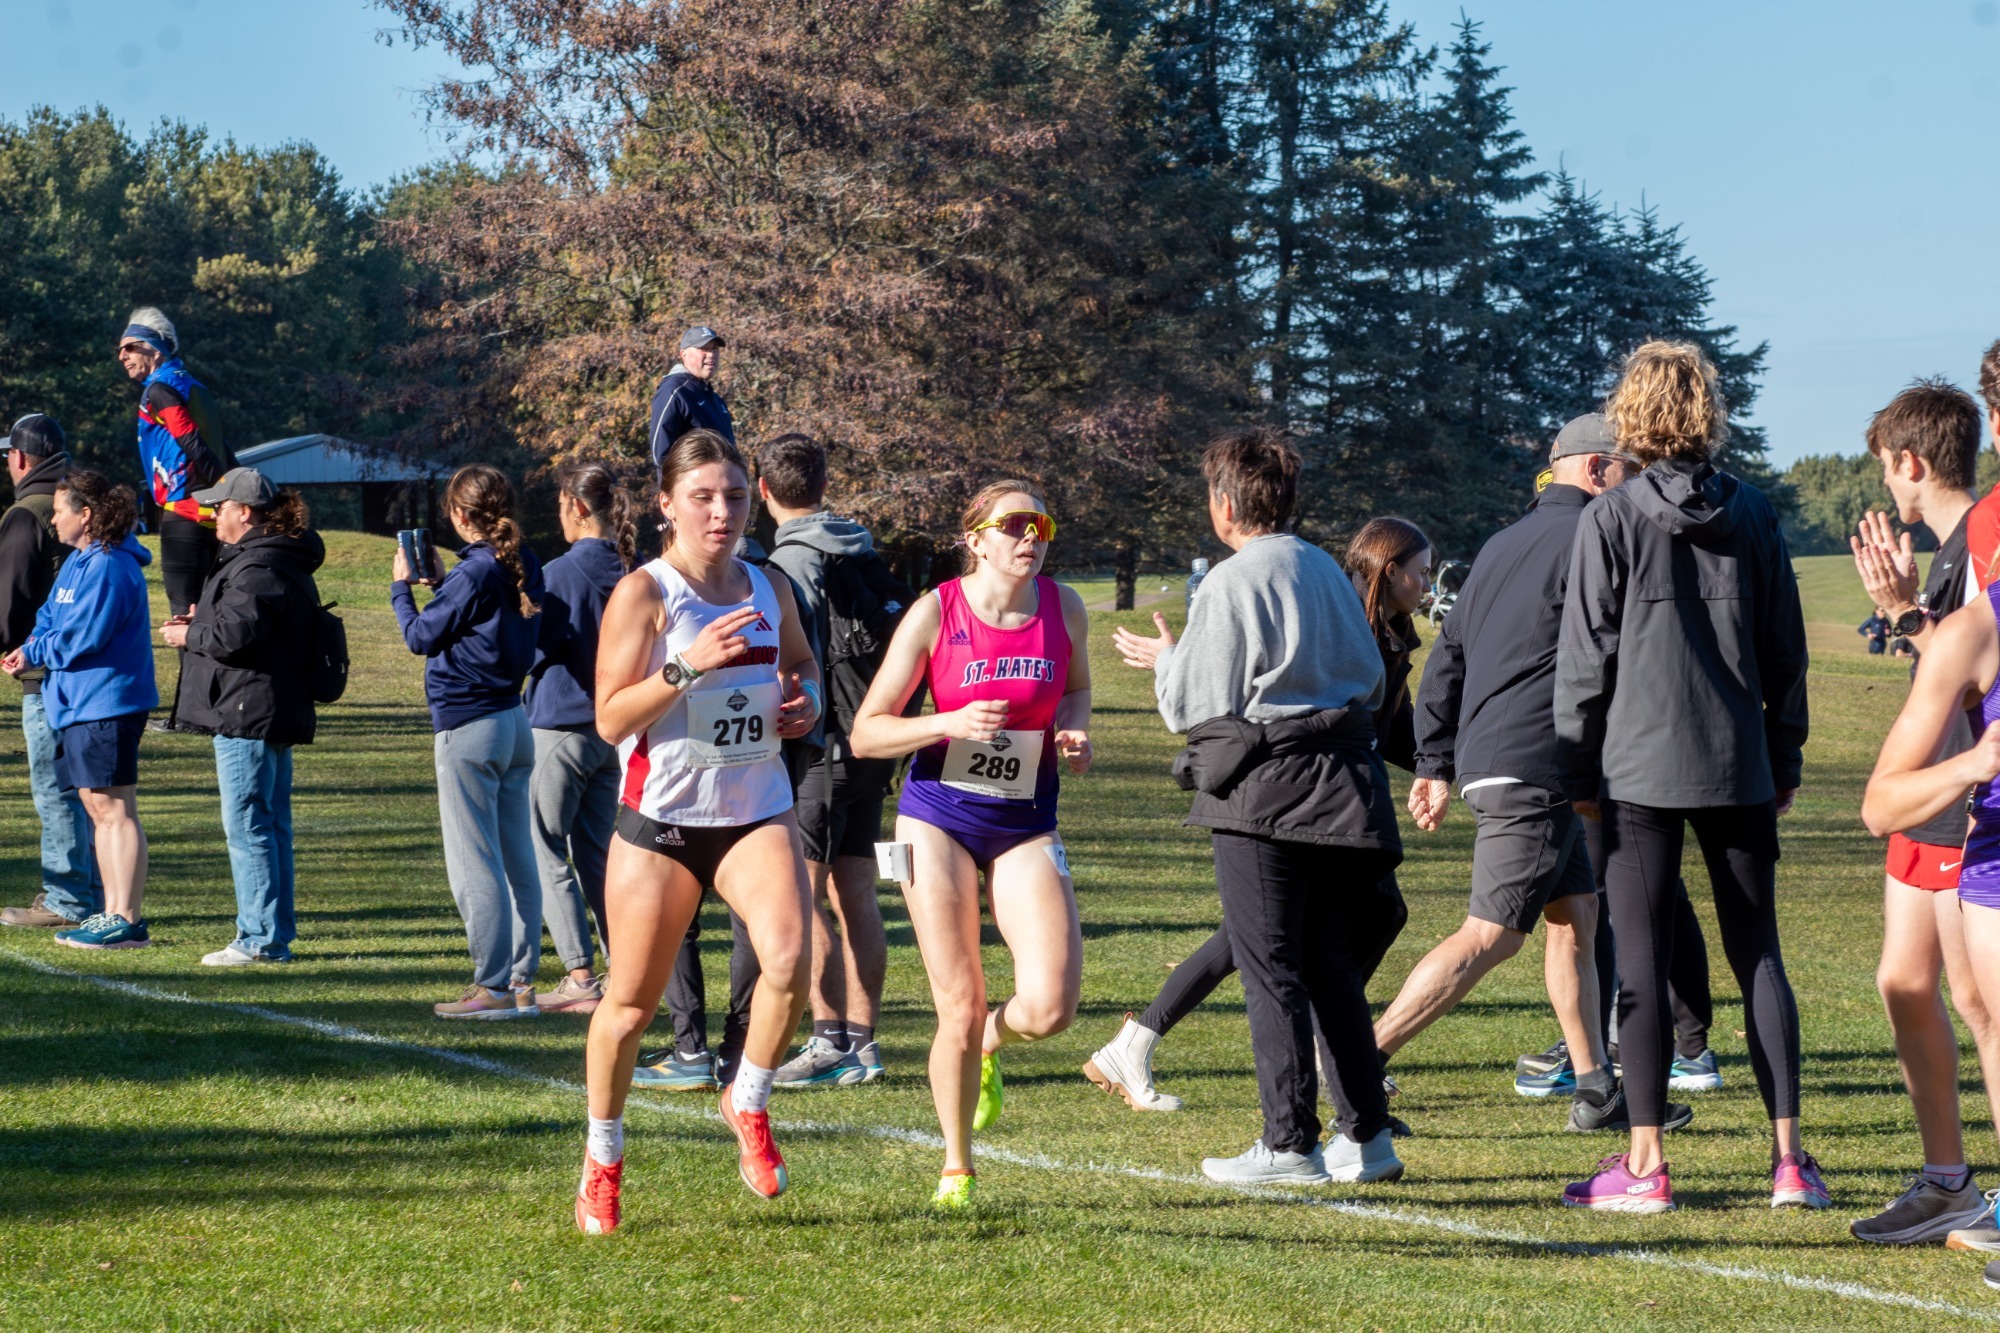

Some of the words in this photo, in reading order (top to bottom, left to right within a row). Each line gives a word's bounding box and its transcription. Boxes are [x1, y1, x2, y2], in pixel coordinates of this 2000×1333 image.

[947, 638, 972, 646] adidas
[960, 659, 990, 688] ST.
[992, 656, 1055, 682] KATE'S
[713, 714, 763, 747] 279
[967, 752, 1021, 781] 289
[655, 836, 685, 847] adidas
